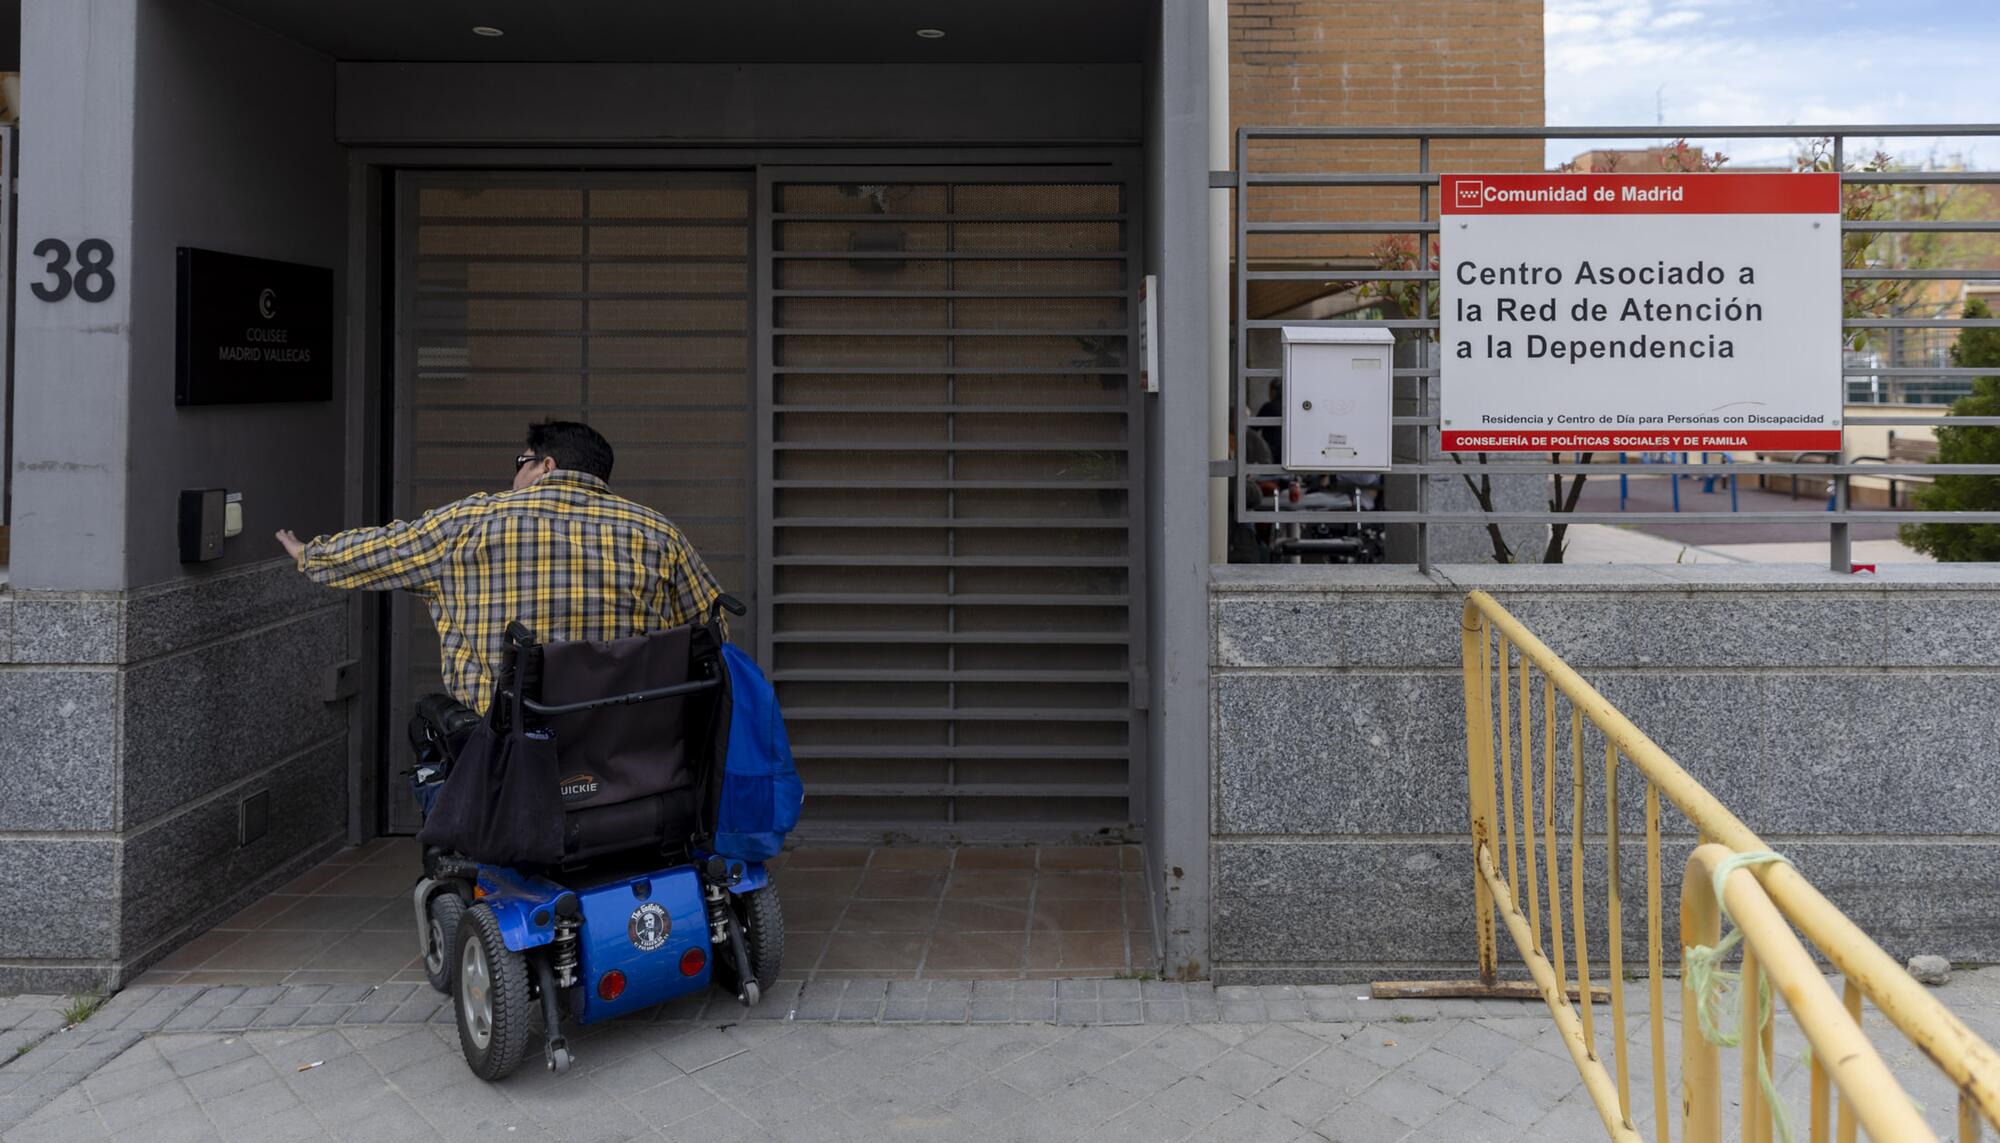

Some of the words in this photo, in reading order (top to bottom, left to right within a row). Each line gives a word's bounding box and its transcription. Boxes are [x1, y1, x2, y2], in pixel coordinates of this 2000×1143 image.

[1483, 186, 1587, 202] Comunidad
[1592, 186, 1616, 202] de
[1621, 186, 1684, 202] Madrid
[30, 237, 116, 304] 38
[1456, 260, 1563, 286] Centro
[1574, 260, 1726, 286] Asociado
[1738, 265, 1756, 285] a
[1456, 297, 1482, 322] la
[1496, 297, 1557, 322] Red
[1570, 297, 1609, 322] de
[1619, 296, 1763, 322] Atención
[247, 327, 287, 343] COLISEE
[219, 346, 261, 361] MADRID
[264, 347, 311, 362] VALLECAS
[1456, 340, 1473, 359] a
[1486, 334, 1513, 359] la
[1526, 334, 1735, 365] Dependencia
[1482, 414, 1544, 424] Residencia
[1546, 415, 1554, 426] y
[1556, 414, 1596, 424] Centro
[1598, 414, 1613, 424] de
[1616, 414, 1635, 424] Día
[1638, 415, 1664, 426] para
[1666, 414, 1720, 424] Personas
[1722, 415, 1744, 424] con
[1747, 414, 1824, 426] Discapacidad
[1456, 435, 1529, 446] CONSEJERÍA
[1531, 435, 1547, 446] DE
[1550, 434, 1611, 446] POLÍTICAS
[1612, 435, 1670, 446] SOCIALES
[1672, 435, 1682, 446] Y
[1683, 435, 1699, 446] DE
[1702, 435, 1748, 446] FAMILIA
[560, 783, 598, 795] UICKIE
